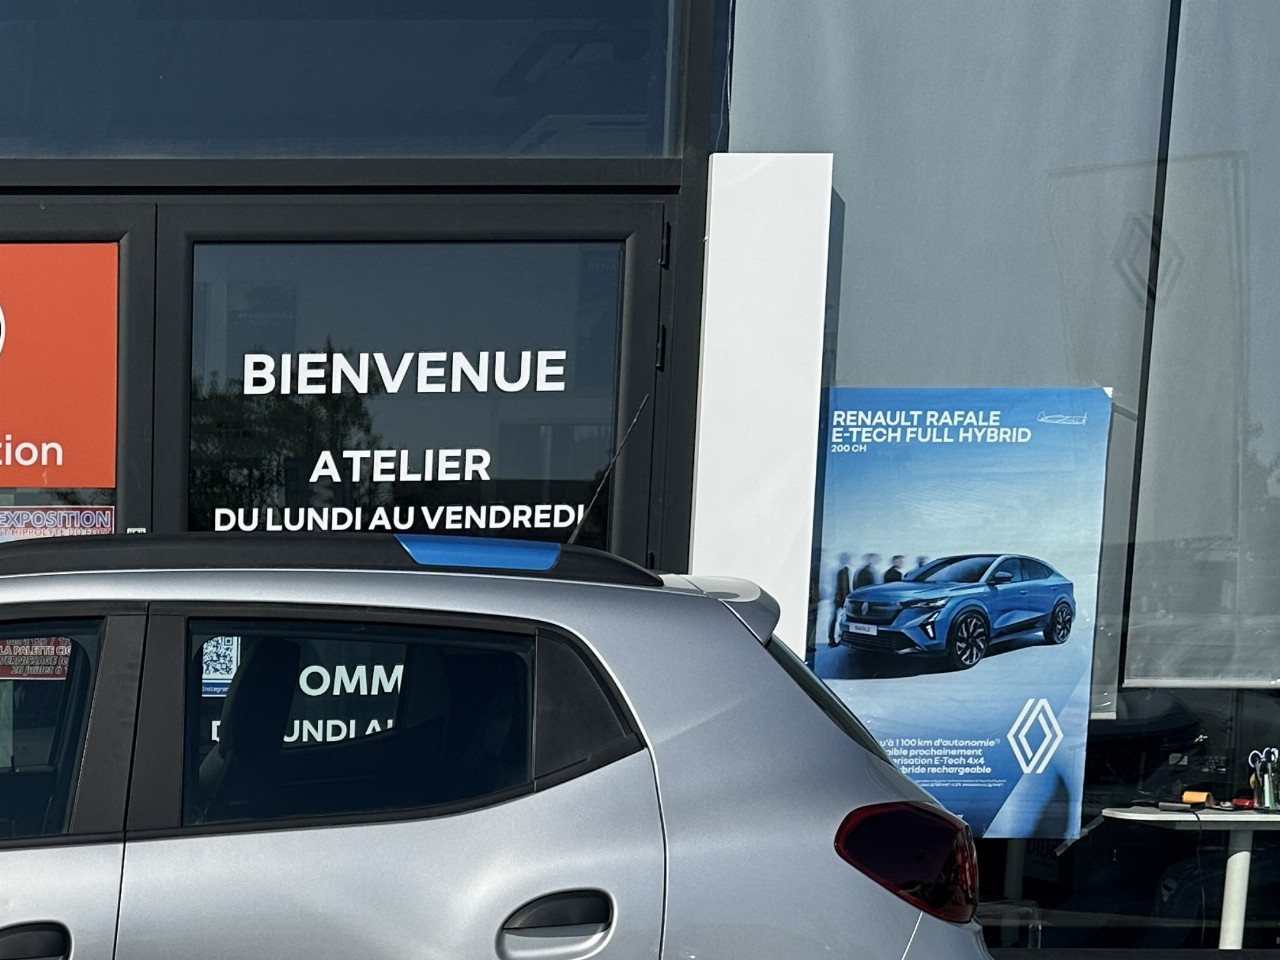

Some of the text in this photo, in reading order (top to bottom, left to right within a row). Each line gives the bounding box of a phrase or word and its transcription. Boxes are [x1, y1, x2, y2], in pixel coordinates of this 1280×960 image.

[243, 350, 567, 395] BIENVENUE
[832, 410, 1001, 426] RENAULT RAFALE
[831, 427, 1032, 443] E-TECH FULL HYBRID
[830, 444, 867, 453] 200 CH
[308, 449, 491, 483] ATELIER
[214, 504, 585, 531] DU LUNDI AU VENDREDI
[918, 738, 933, 748] km
[909, 747, 982, 757] prochainement
[933, 756, 967, 766] E-Tech
[926, 764, 993, 777] rechargeable
